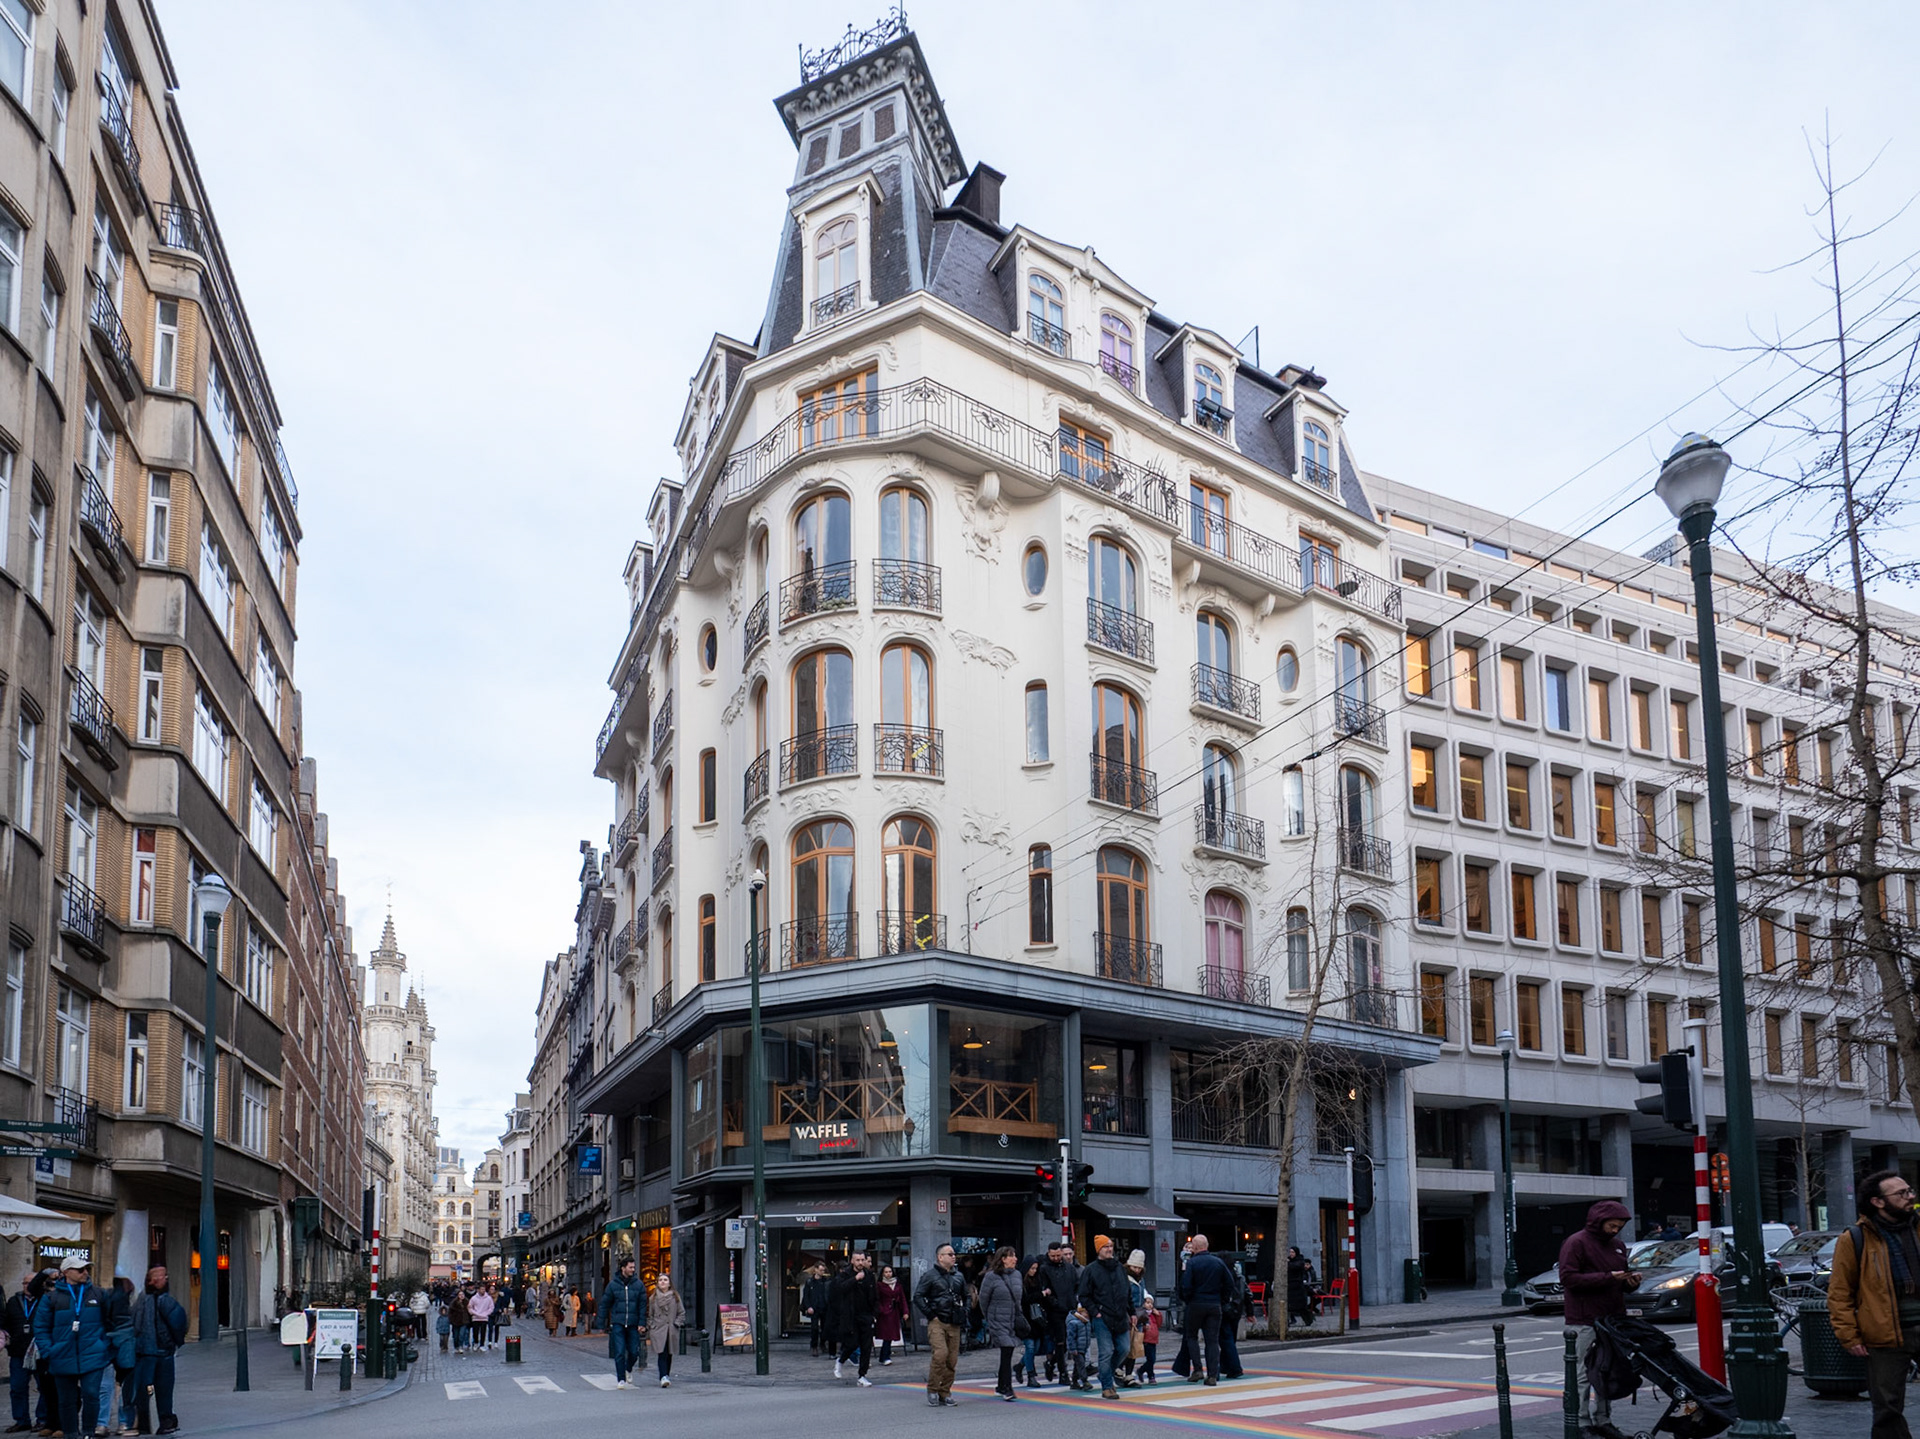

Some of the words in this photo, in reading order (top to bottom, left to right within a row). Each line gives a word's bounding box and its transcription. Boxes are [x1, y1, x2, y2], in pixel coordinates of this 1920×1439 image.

[795, 1123, 848, 1139] WAFFLE
[819, 1137, 858, 1150] factory
[67, 1248, 89, 1259] HOUSE
